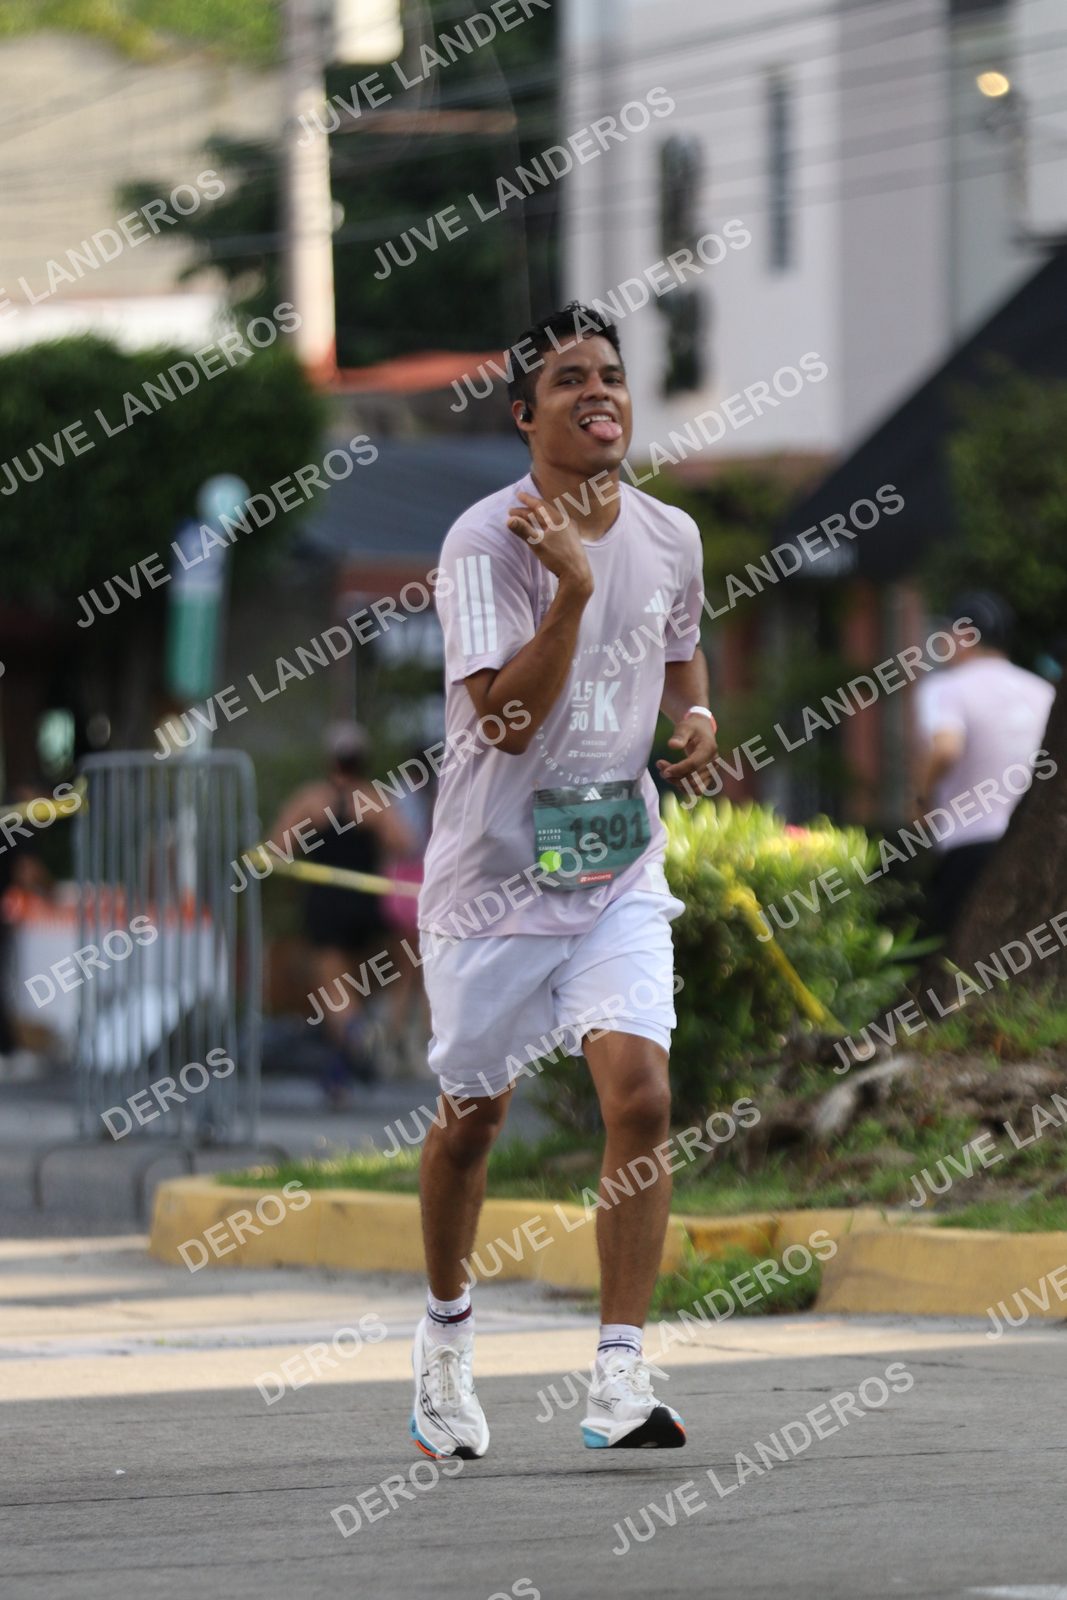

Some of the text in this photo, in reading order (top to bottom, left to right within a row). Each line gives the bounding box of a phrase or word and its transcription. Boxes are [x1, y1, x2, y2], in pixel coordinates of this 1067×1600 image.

[572, 681, 594, 701] 15
[594, 681, 621, 732] K
[570, 711, 589, 731] 30
[569, 811, 645, 854] 1891
